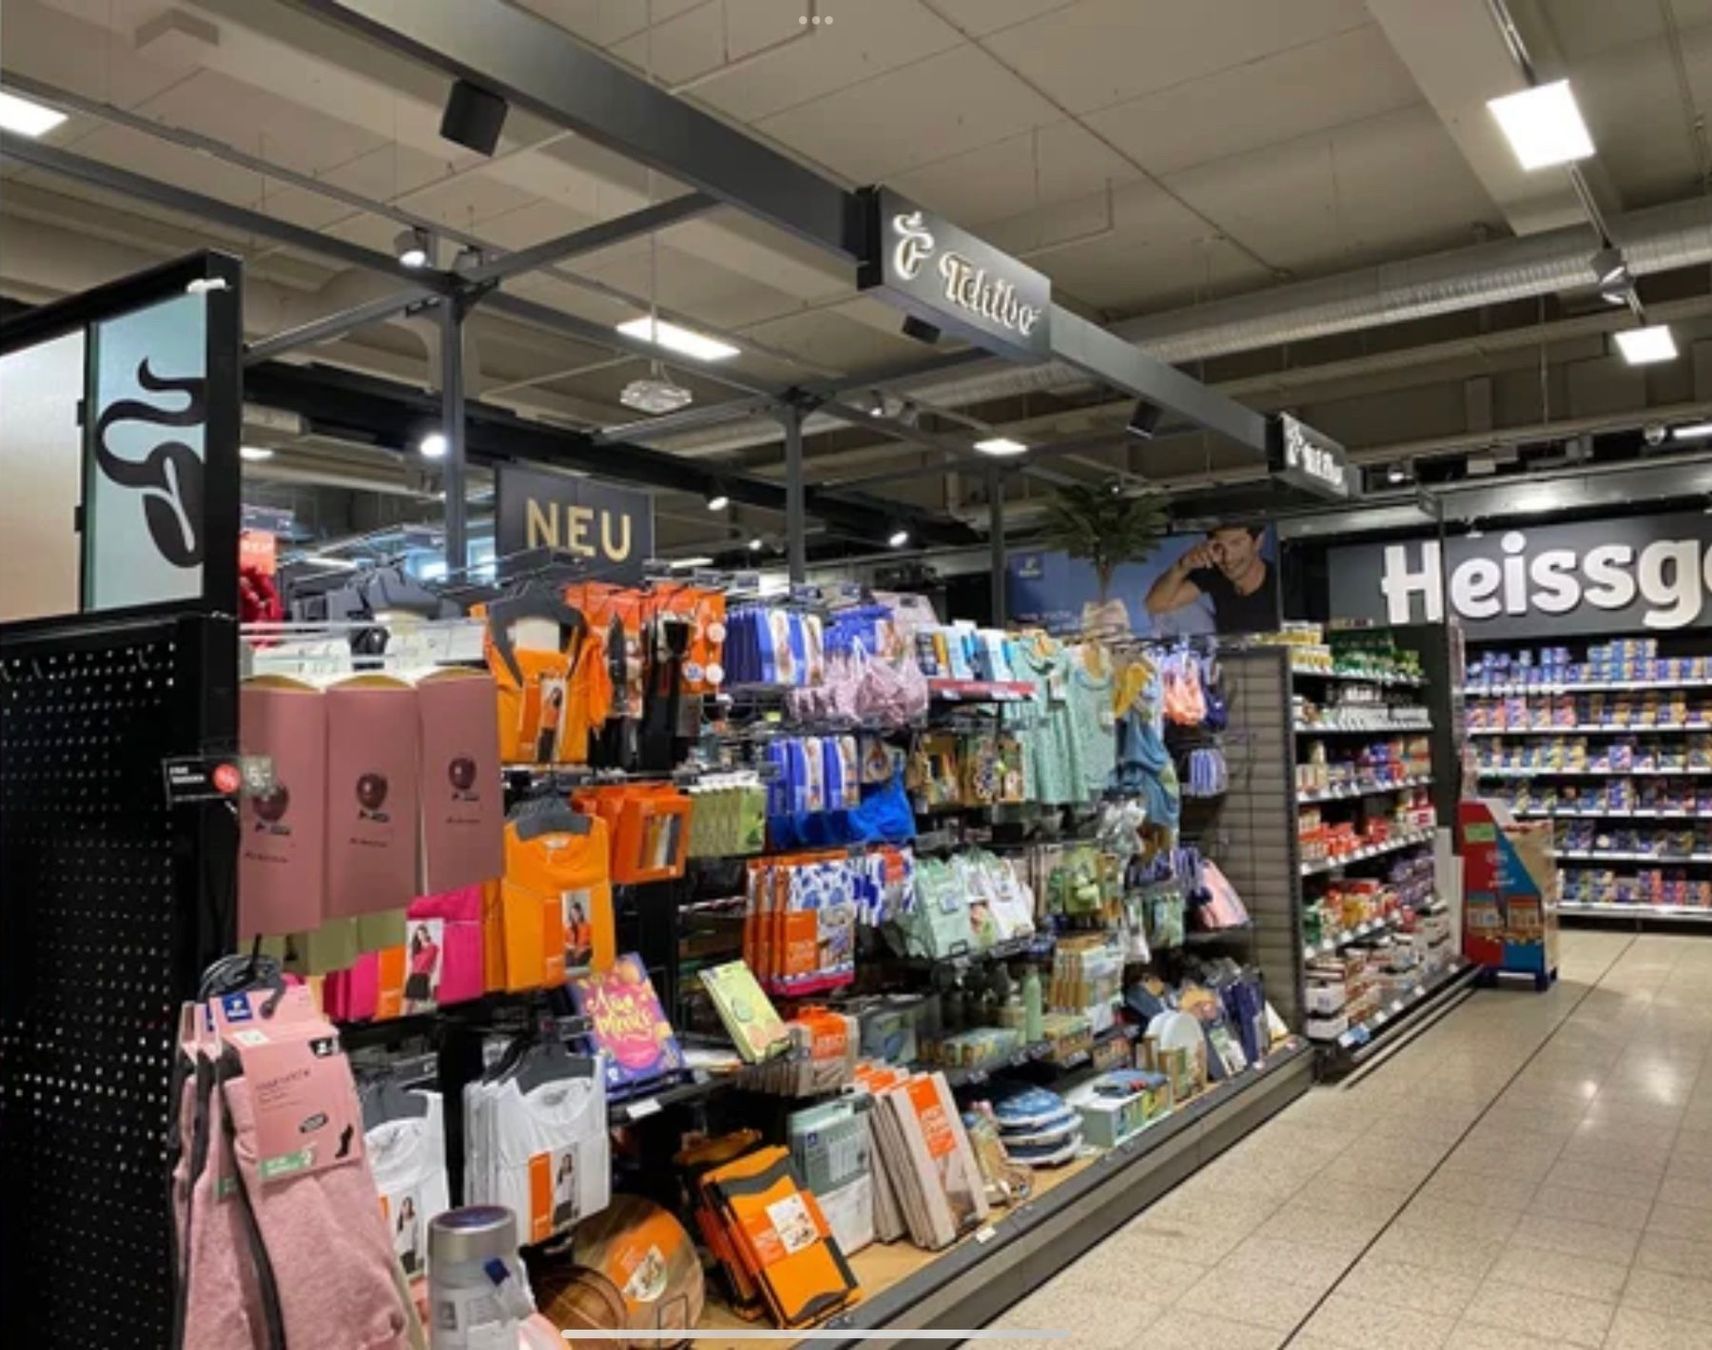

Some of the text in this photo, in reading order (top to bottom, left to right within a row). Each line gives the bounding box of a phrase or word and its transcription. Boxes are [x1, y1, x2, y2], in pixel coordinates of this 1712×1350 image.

[939, 251, 1041, 336] Tchibo
[527, 498, 631, 562] NEU
[1381, 530, 1712, 629] Heissg
